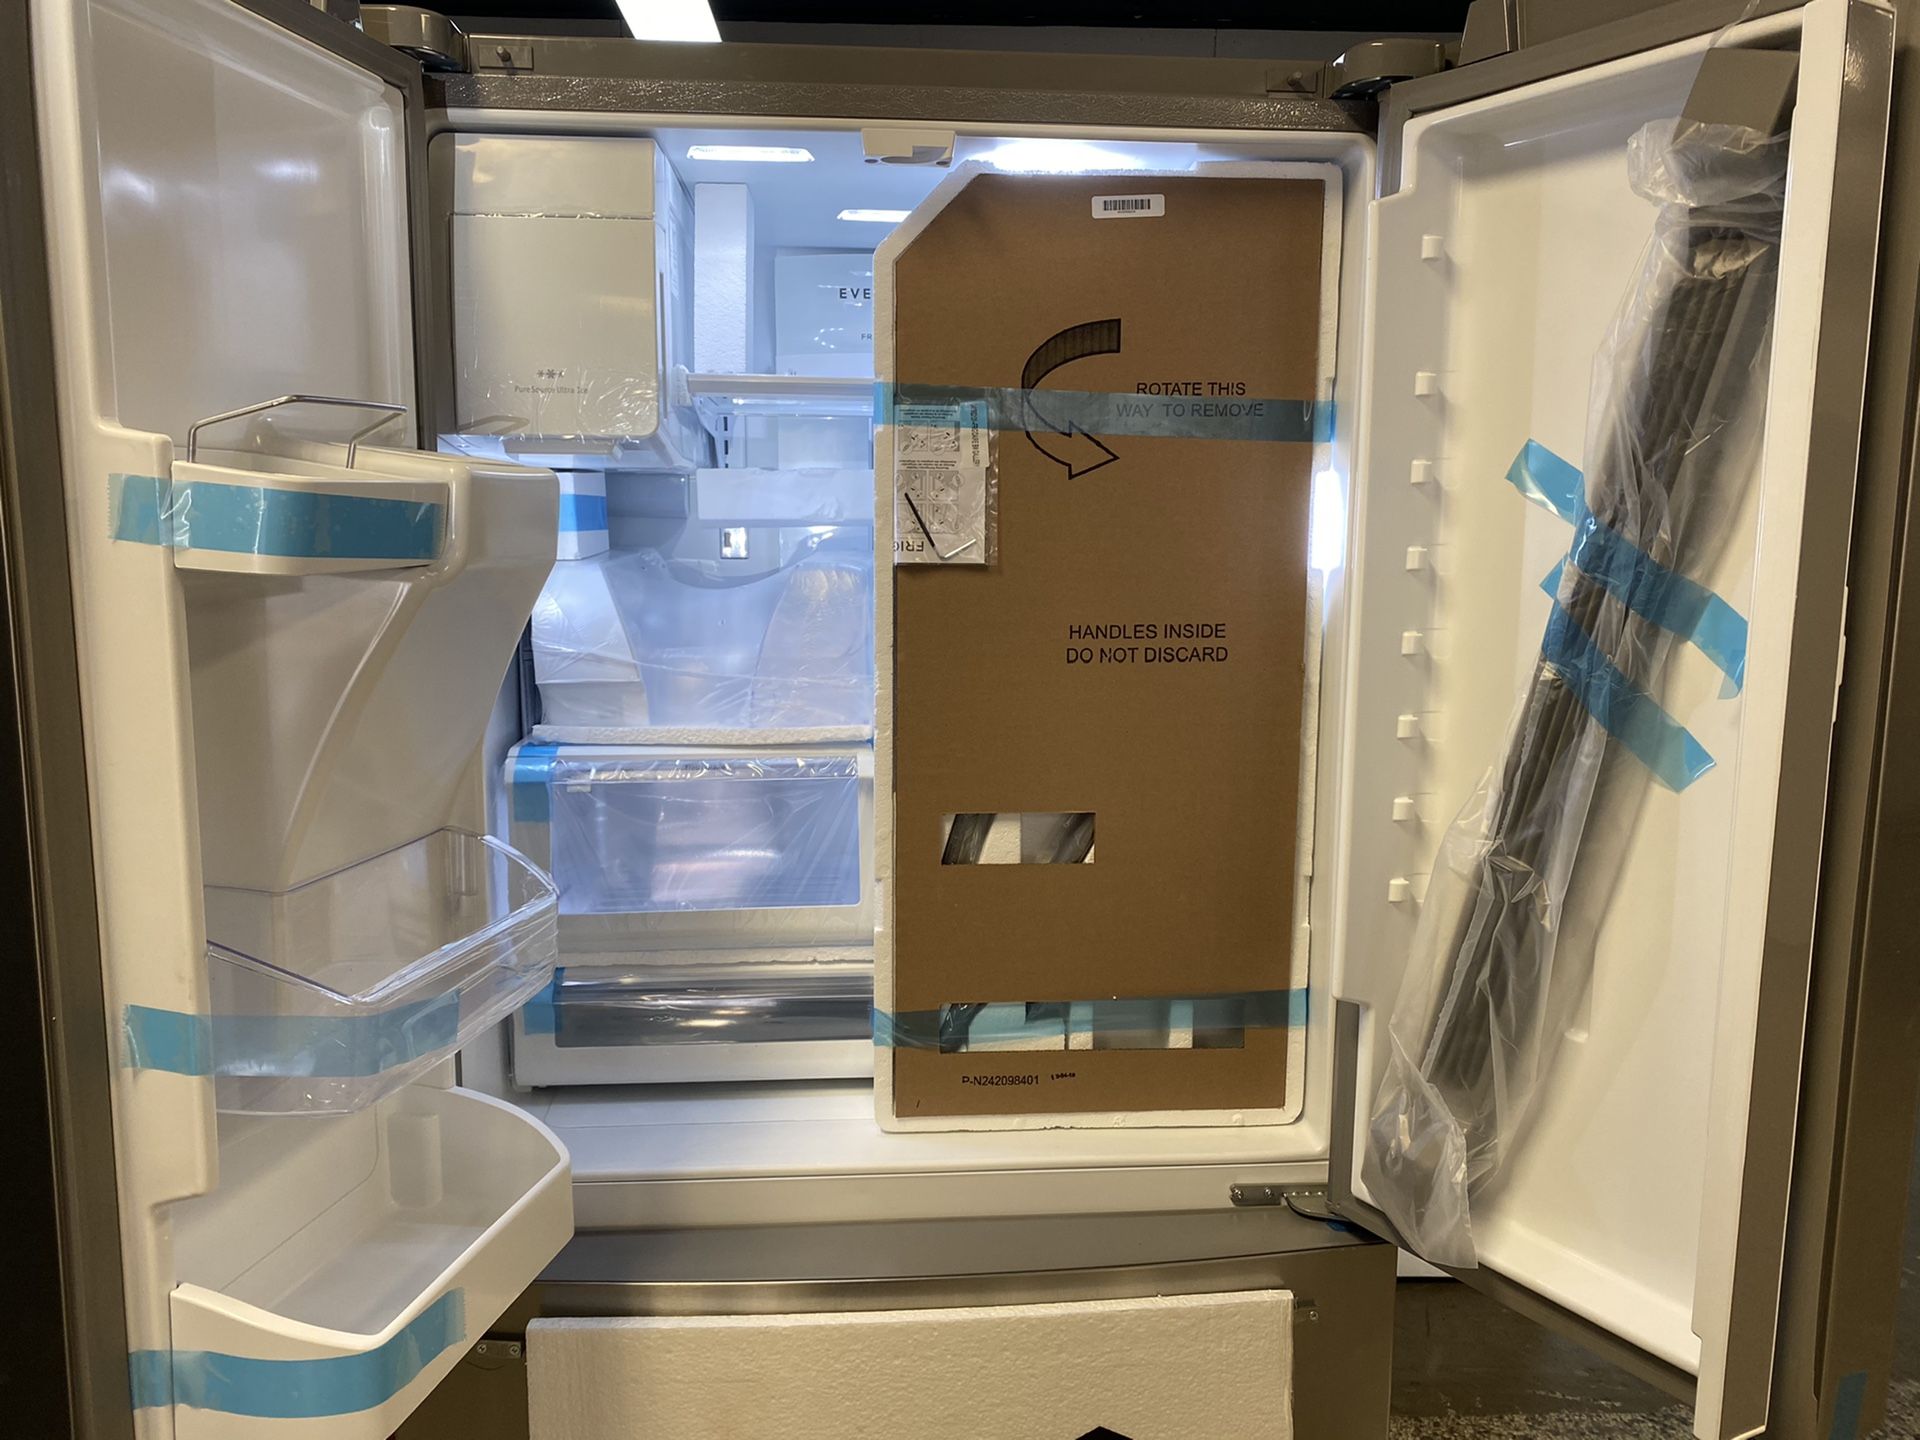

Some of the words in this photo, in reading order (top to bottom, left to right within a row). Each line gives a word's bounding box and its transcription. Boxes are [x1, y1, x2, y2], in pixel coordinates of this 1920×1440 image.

[839, 287, 872, 300] EVE
[1136, 382, 1203, 396] ROTATE
[1207, 381, 1246, 396] THIS
[1116, 403, 1154, 418] WAY
[1162, 403, 1186, 418] TO
[1190, 402, 1264, 418] REMOVE
[1069, 624, 1158, 640] HANDLES
[1164, 623, 1226, 639] INSIDE
[1066, 647, 1094, 664] DO
[1099, 647, 1139, 664] NOT
[1144, 646, 1229, 663] DISCARD
[961, 1075, 1039, 1086] P-N242098401
